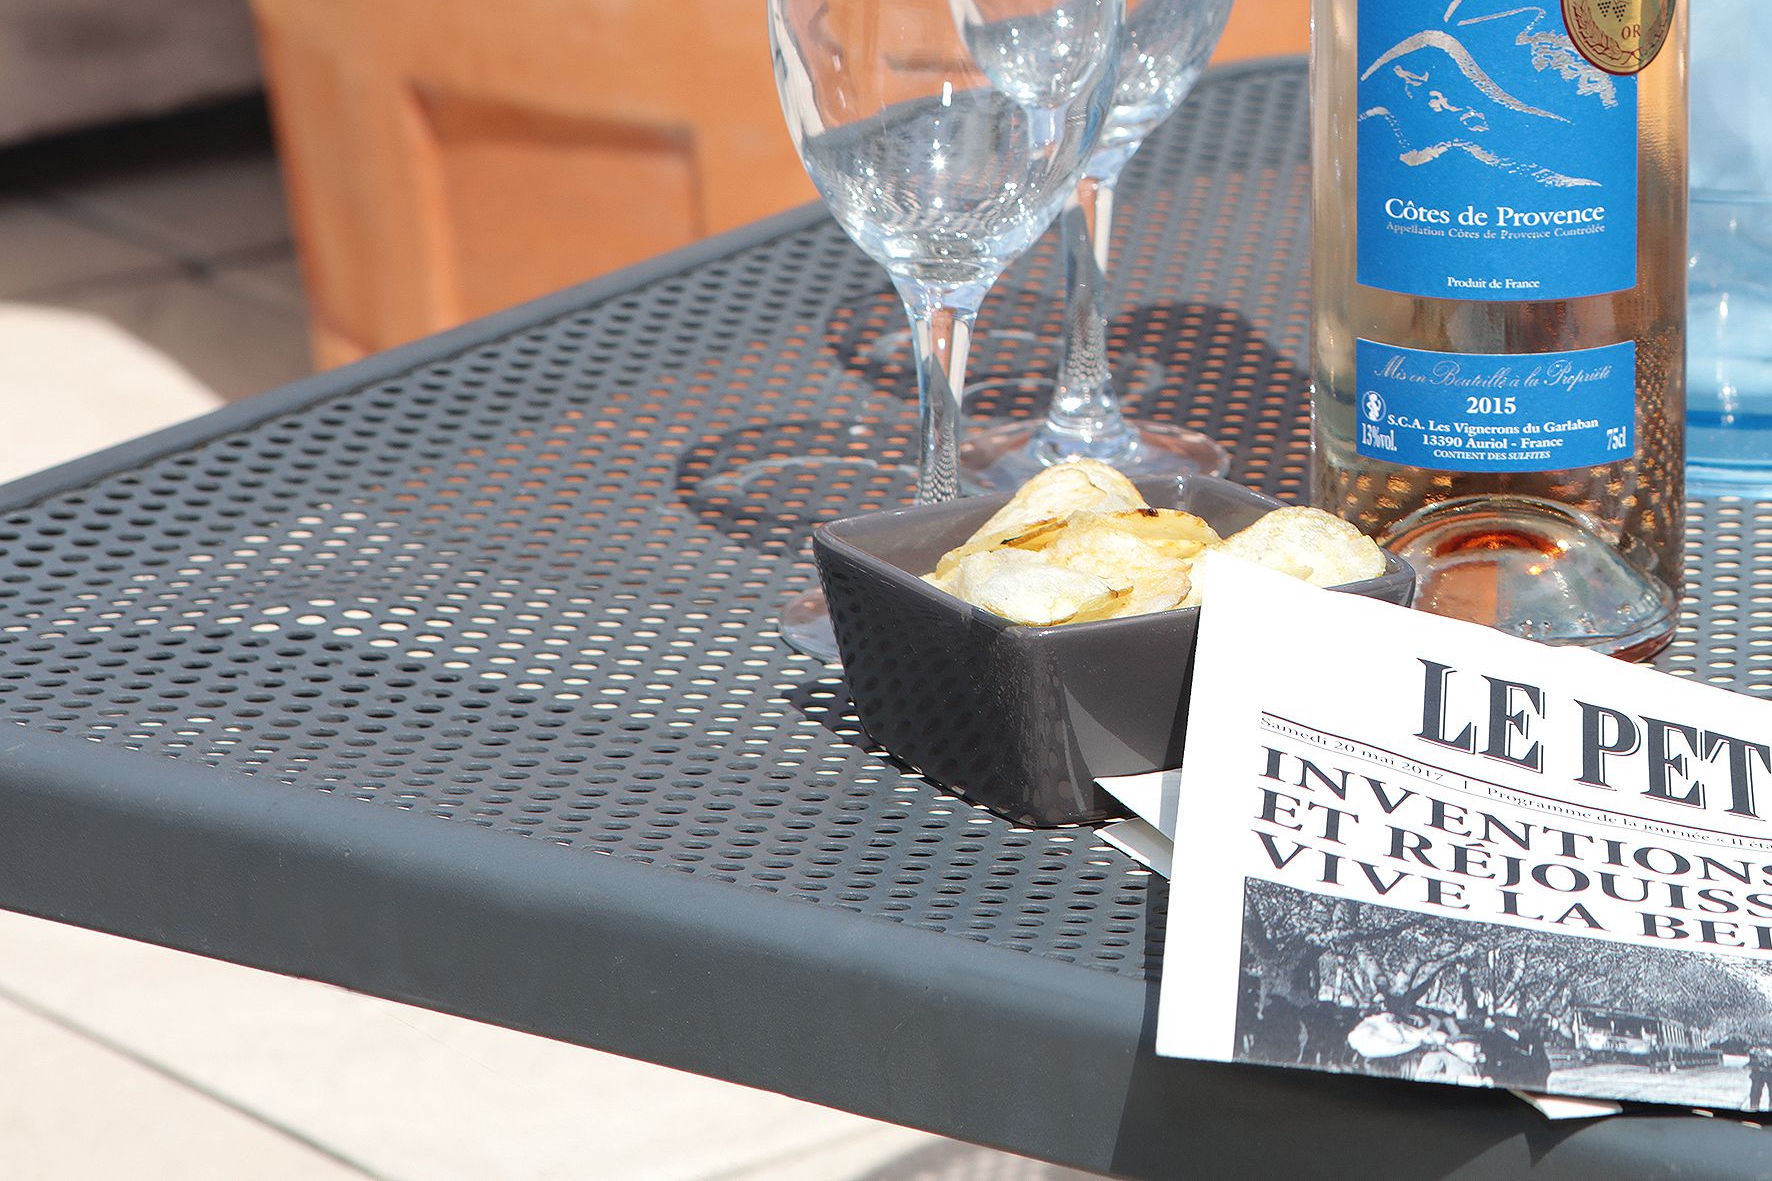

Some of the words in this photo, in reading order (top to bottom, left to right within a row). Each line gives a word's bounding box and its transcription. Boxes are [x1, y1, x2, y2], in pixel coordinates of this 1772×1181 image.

[1621, 25, 1641, 40] OR
[1385, 198, 1450, 224] Côtes
[1458, 205, 1488, 226] de
[1496, 206, 1605, 227] Provence
[1386, 221, 1444, 238] Appellation
[1448, 228, 1480, 239] Côtes
[1483, 229, 1497, 239] de
[1500, 229, 1550, 239] Provence
[1554, 223, 1605, 237] Contrôlée
[1447, 277, 1486, 289] Produit
[1488, 279, 1502, 288] de
[1505, 279, 1540, 289] France
[1374, 355, 1406, 380] Mis
[1409, 373, 1426, 383] en
[1466, 397, 1517, 414] 2015
[1387, 415, 1425, 430] S.C.A.
[1429, 421, 1450, 432] Les
[1453, 422, 1520, 436] Vignerons
[1523, 422, 1540, 433] du
[1543, 418, 1599, 433] Garlaban
[1422, 434, 1462, 447] 13390
[1466, 436, 1507, 449] Auriol
[1521, 438, 1563, 448] France
[1433, 449, 1486, 459] CONTIENT
[1487, 451, 1507, 460] DES
[1508, 450, 1551, 459] SULFITES
[1413, 657, 1546, 774] LE
[1260, 716, 1327, 746] Samedi
[1334, 740, 1355, 753] 20
[1362, 750, 1395, 765] mai
[1402, 761, 1443, 781] 2017
[1488, 787, 1591, 820] Programme
[1597, 813, 1617, 824] de
[1623, 818, 1637, 828] la
[1642, 822, 1711, 842] journée
[1254, 787, 1359, 844] ET
[1250, 830, 1470, 910] VIVE
[1496, 890, 1611, 931] LA
